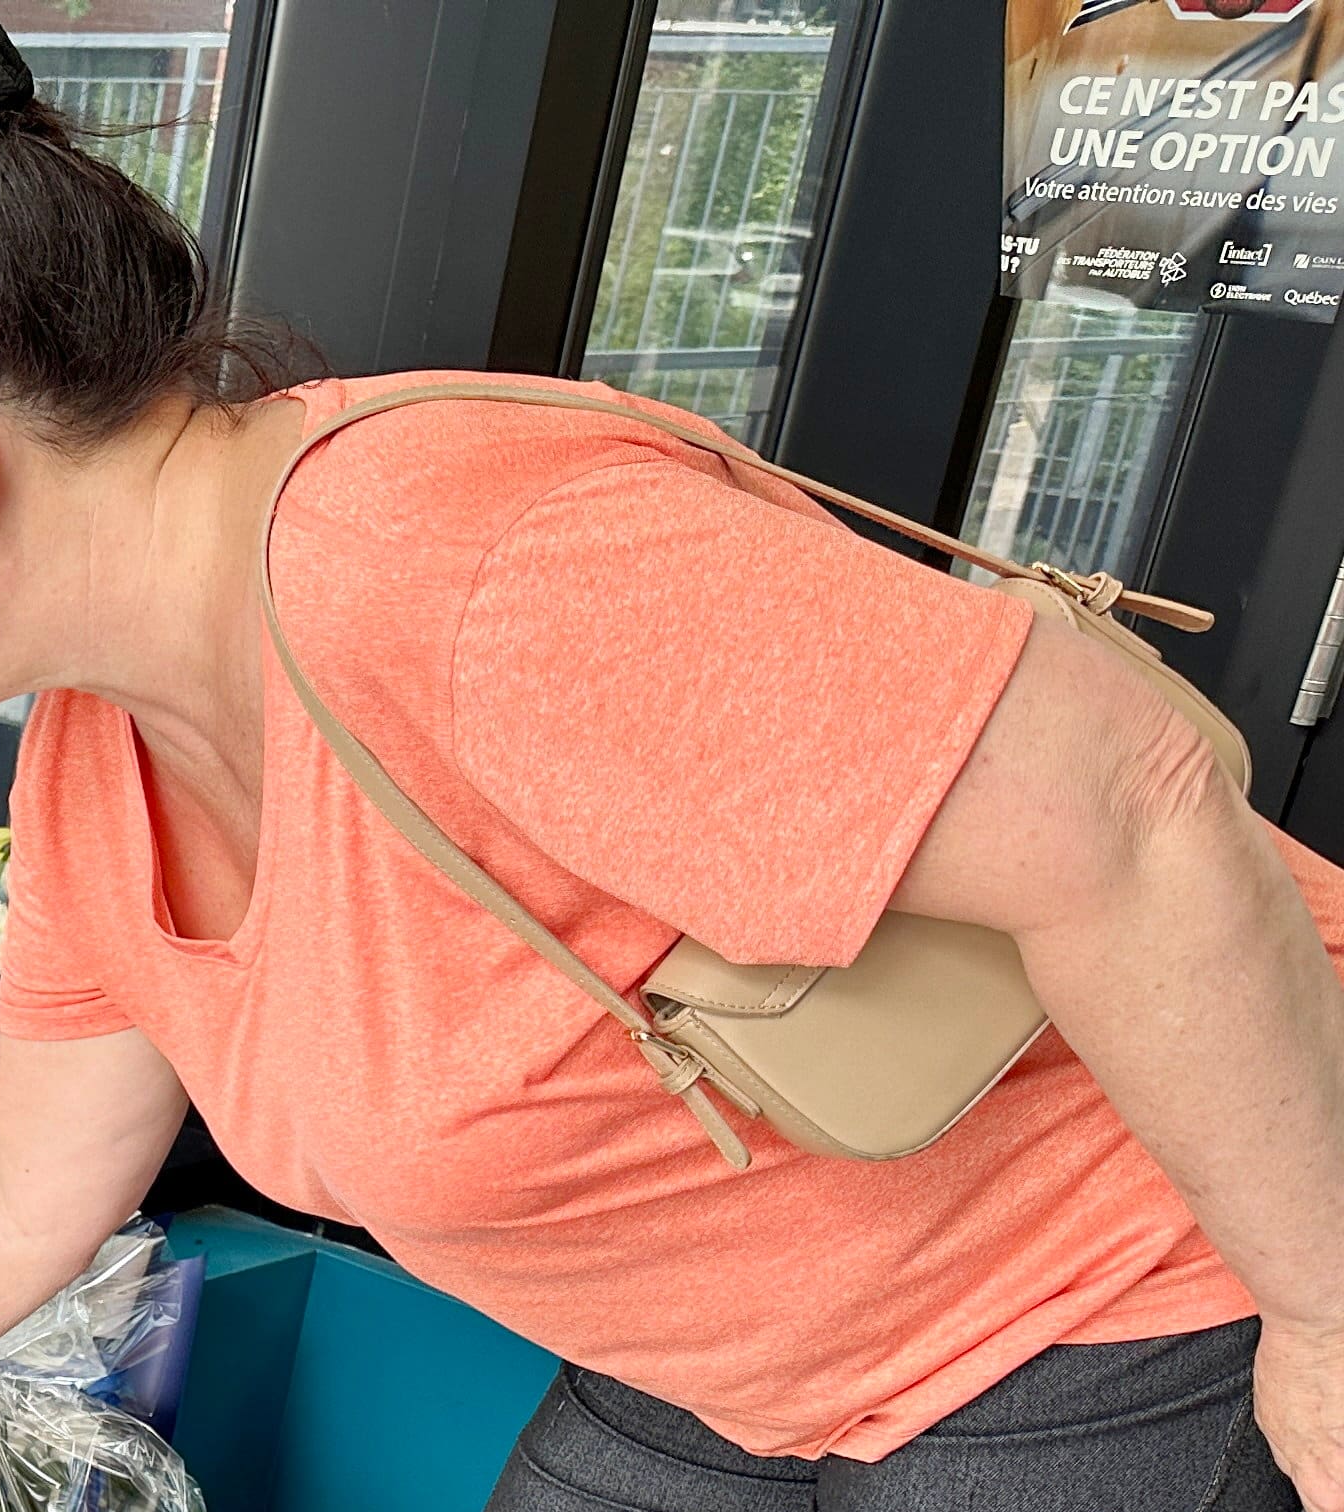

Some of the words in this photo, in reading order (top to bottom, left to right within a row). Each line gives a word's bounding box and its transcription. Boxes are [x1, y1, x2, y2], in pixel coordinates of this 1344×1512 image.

[1059, 76, 1115, 116] CE
[1120, 78, 1258, 120] N'EST
[1260, 80, 1344, 124] PAS
[1050, 127, 1143, 169] UNE
[1149, 131, 1336, 178] OPTION
[1024, 177, 1075, 200] Votre
[1078, 181, 1175, 206] attention
[1179, 189, 1239, 209] sauve
[1246, 188, 1285, 213] des
[1292, 193, 1338, 215] vies
[1001, 234, 1040, 255] S-TU
[1097, 246, 1160, 261] FÉDÉRATION
[1072, 255, 1155, 270] TRANSPORTEURS
[1103, 270, 1152, 280] AUTOBUS
[1284, 288, 1340, 306] Québec
